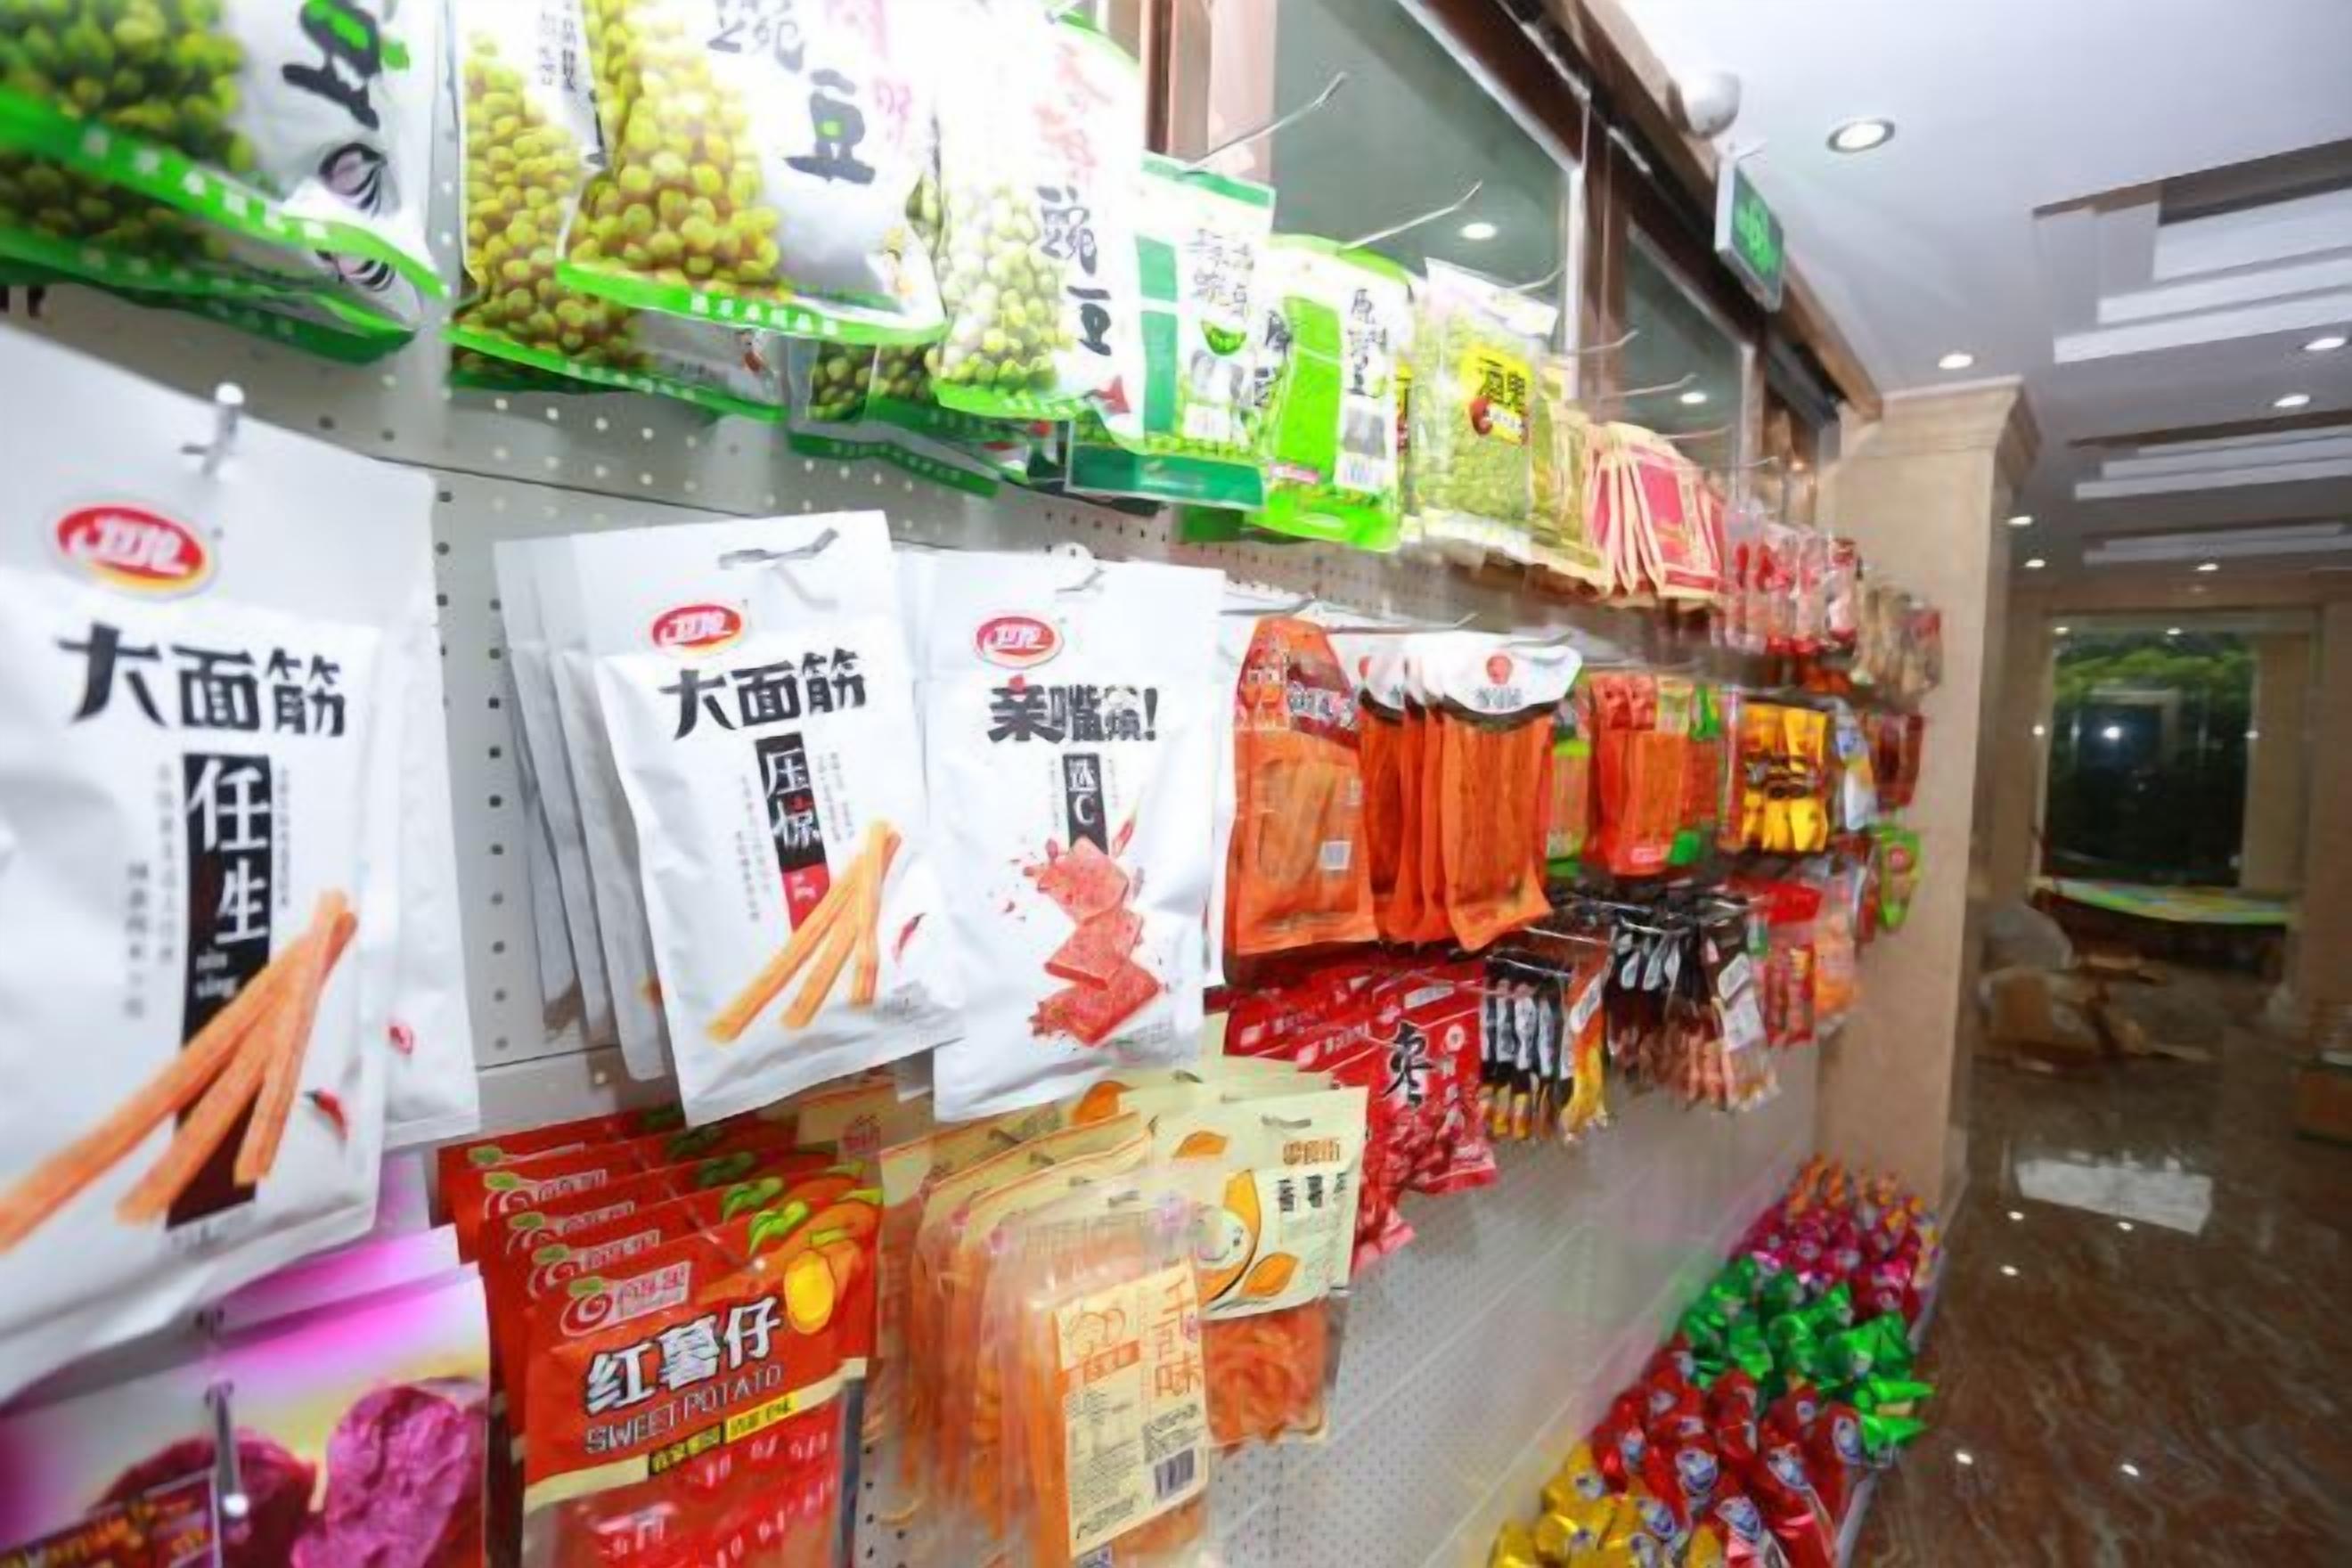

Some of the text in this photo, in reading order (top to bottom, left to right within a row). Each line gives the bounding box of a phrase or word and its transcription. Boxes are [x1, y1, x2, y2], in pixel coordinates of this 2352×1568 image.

[56, 622, 346, 737] 大面筋
[657, 647, 866, 740] 大面筋
[585, 1296, 781, 1416] 红薯仔
